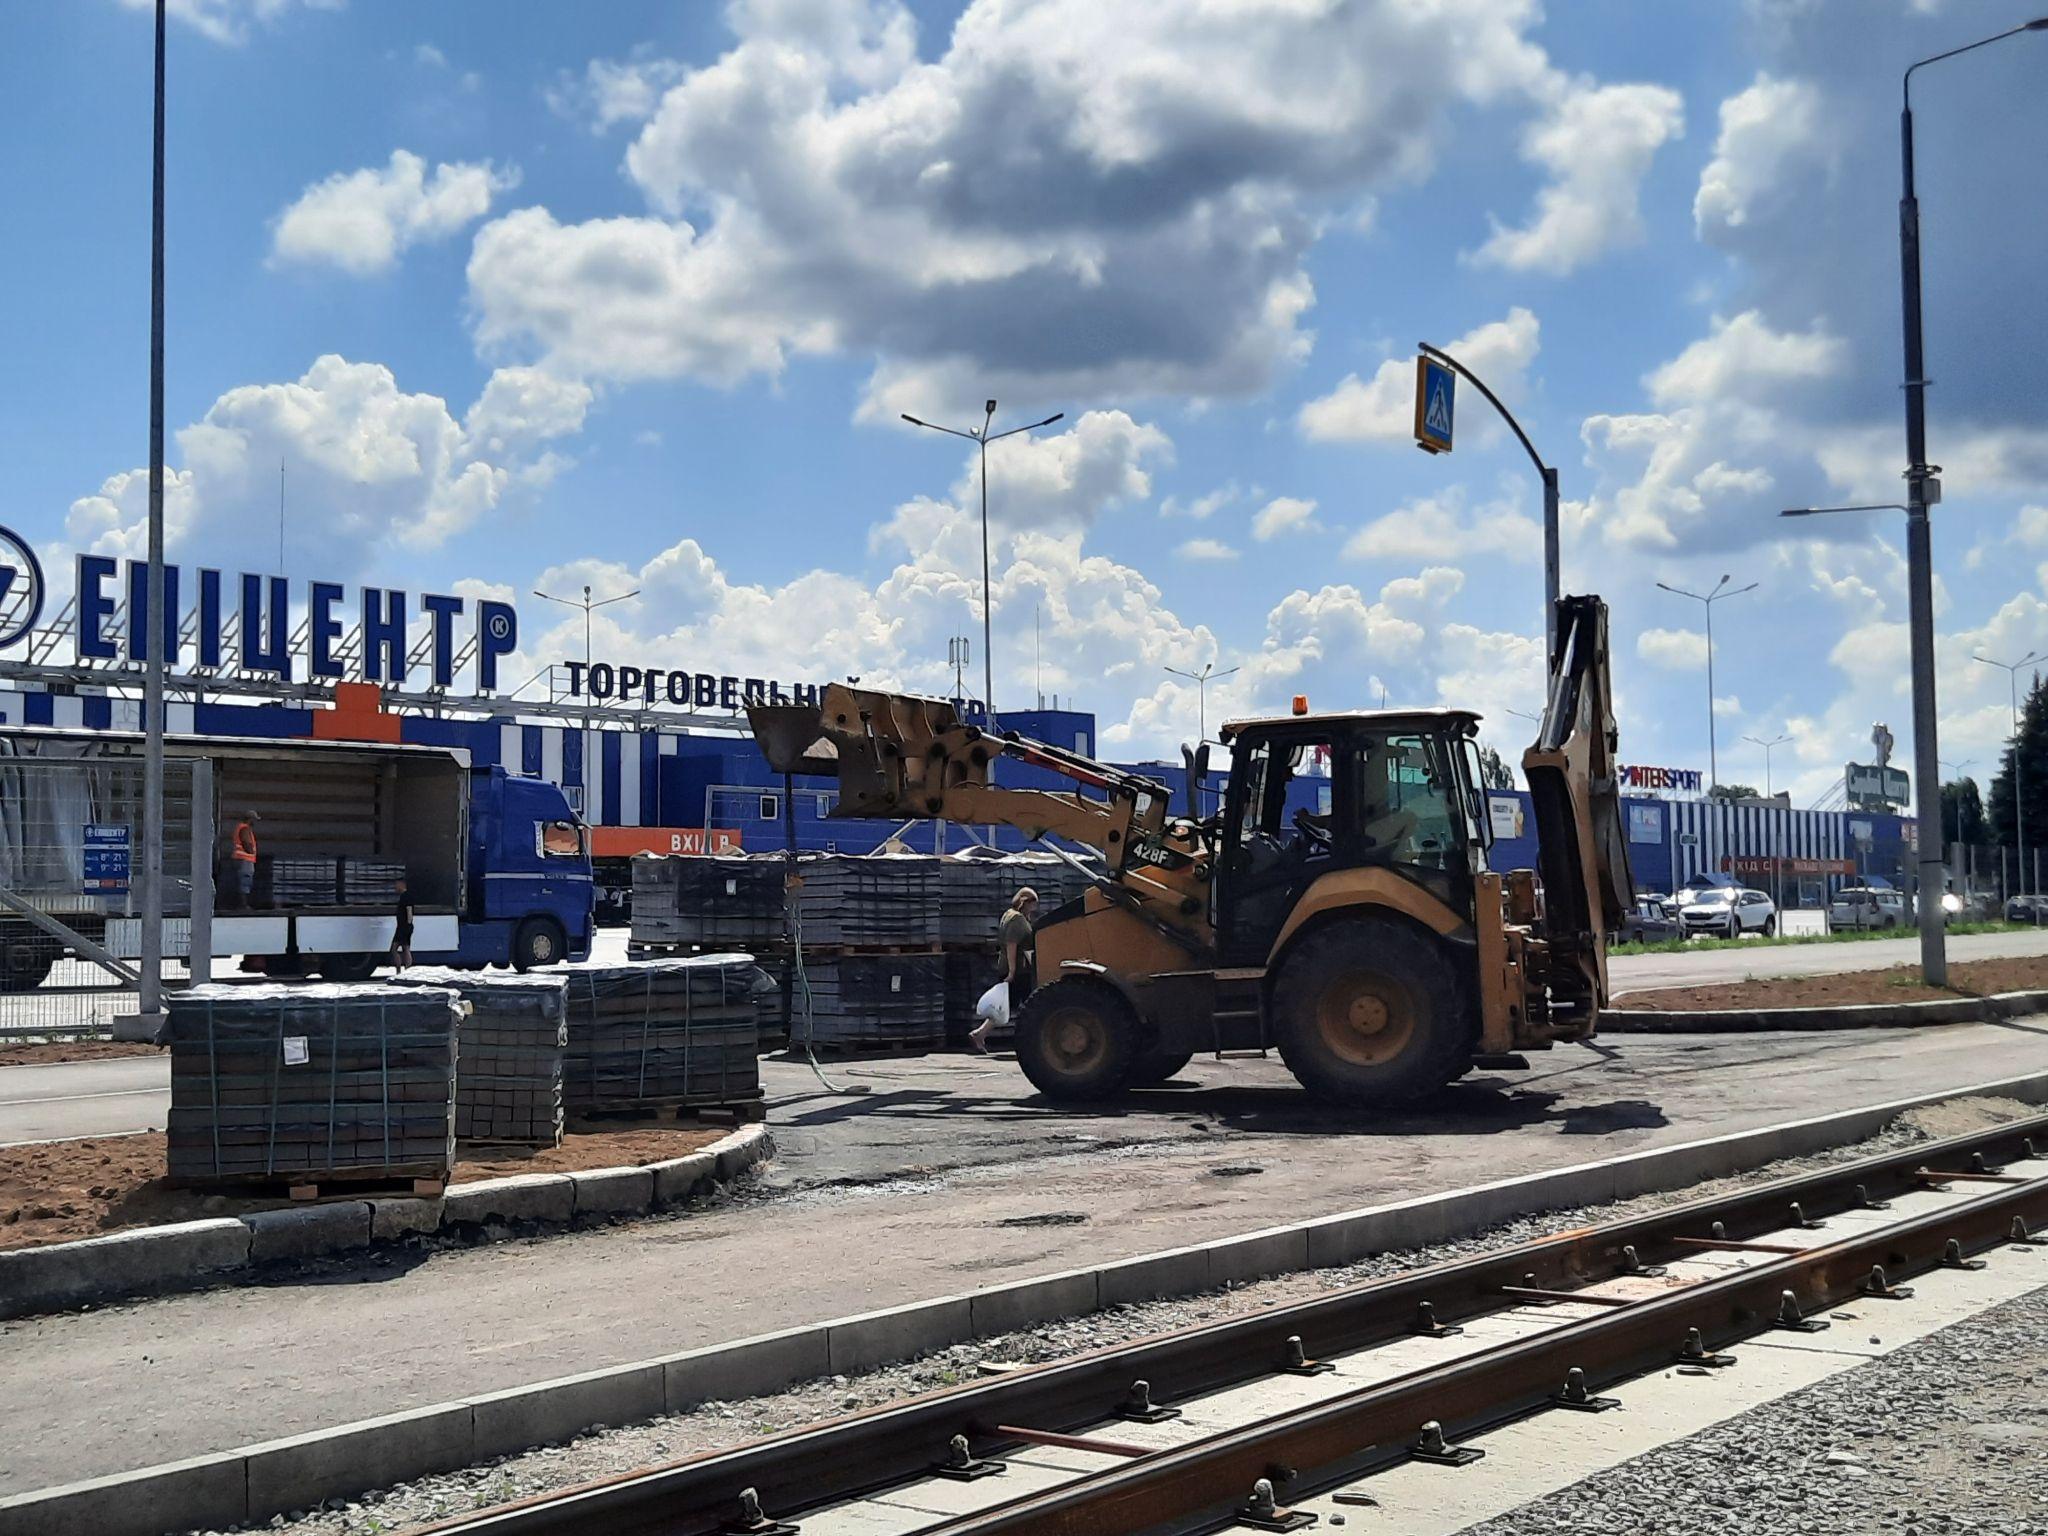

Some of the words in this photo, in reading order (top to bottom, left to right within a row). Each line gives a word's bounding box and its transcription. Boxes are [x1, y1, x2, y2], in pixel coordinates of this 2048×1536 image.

[76, 553, 518, 690] ЕПІЦЕНТР
[564, 660, 862, 710] ТОРГОВЕЛЬН
[1630, 765, 1703, 791] INTERSPORT
[1133, 843, 1169, 865] 428F
